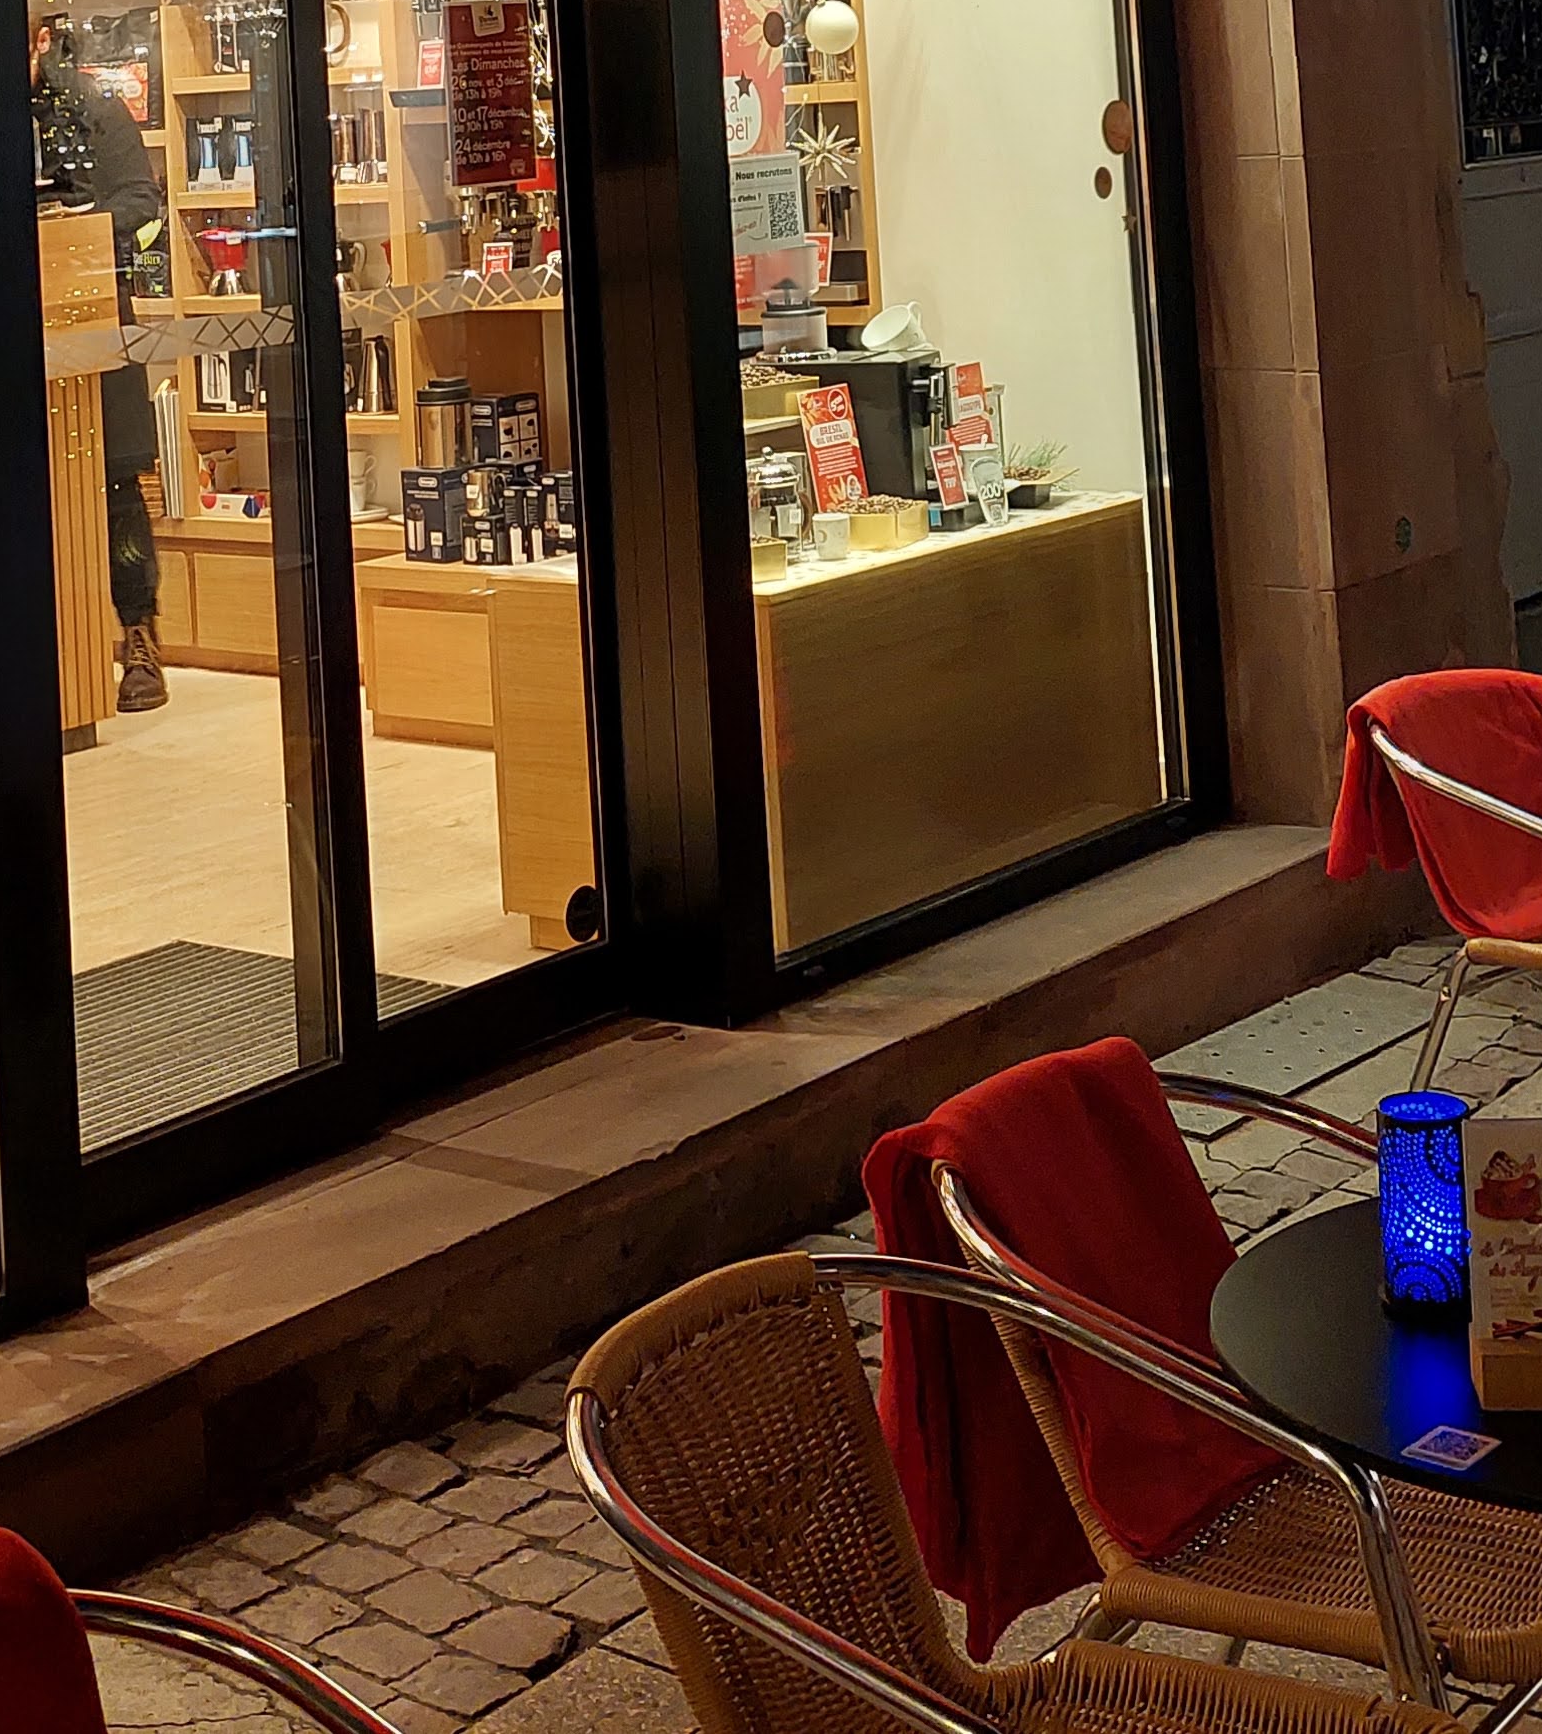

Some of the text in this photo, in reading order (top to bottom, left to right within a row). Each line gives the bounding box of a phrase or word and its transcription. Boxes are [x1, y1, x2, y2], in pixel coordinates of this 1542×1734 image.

[470, 56, 526, 72] Dimanches
[495, 73, 504, 88] 3
[453, 107, 467, 123] 10
[476, 106, 489, 121] 17
[455, 138, 471, 154] 24
[735, 166, 793, 182] Nous recrutons
